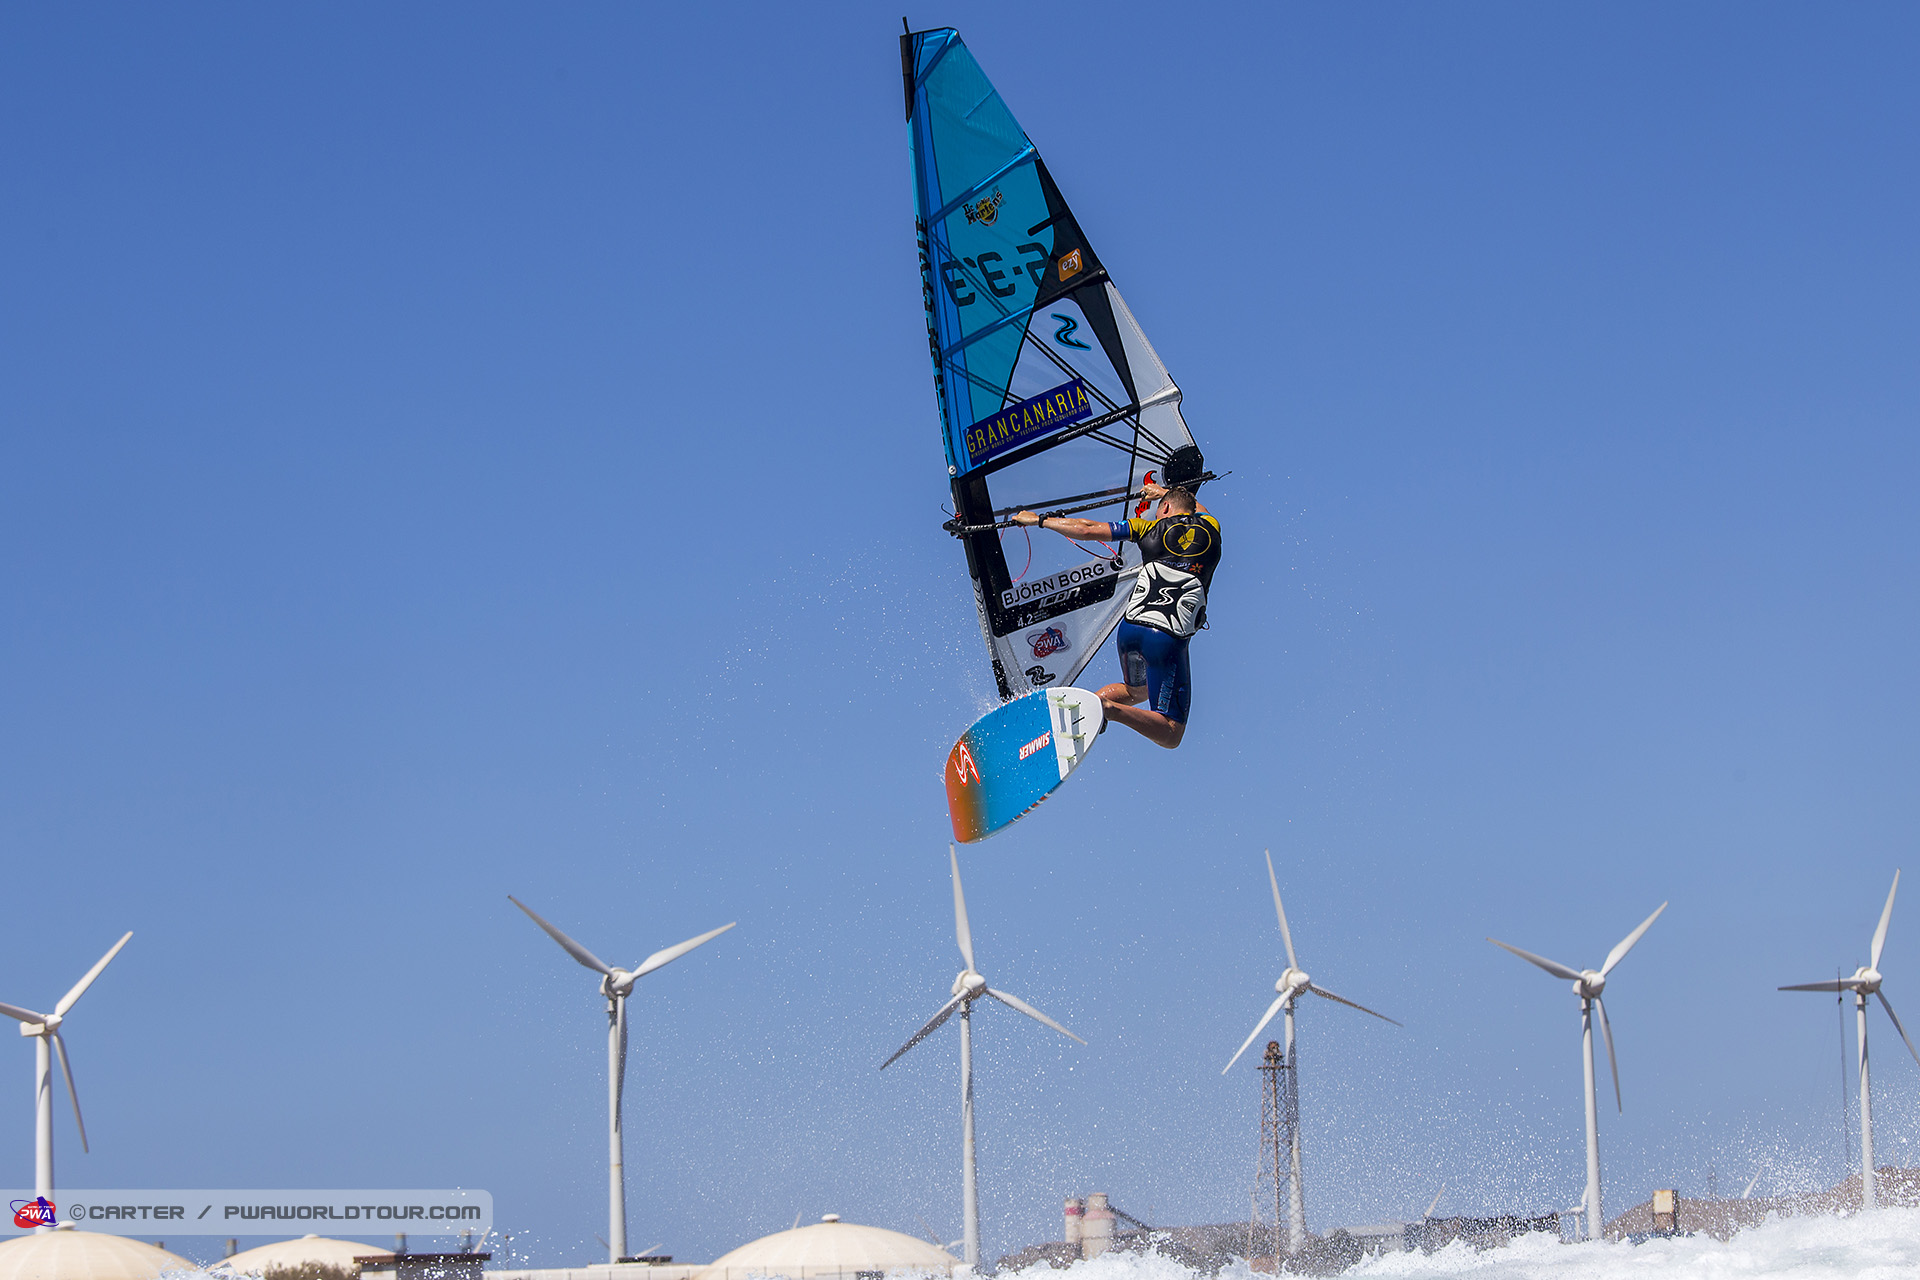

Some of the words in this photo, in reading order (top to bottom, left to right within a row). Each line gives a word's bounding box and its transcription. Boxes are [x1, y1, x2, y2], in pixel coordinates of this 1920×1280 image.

[965, 191, 1003, 226] Martens
[1061, 252, 1080, 272] ezy
[1003, 578, 1056, 606] BJÖRN
[1058, 563, 1105, 588] BORG
[1017, 613, 1035, 628] 4.2
[1037, 637, 1061, 651] PWA
[1019, 731, 1051, 761] SIMMER
